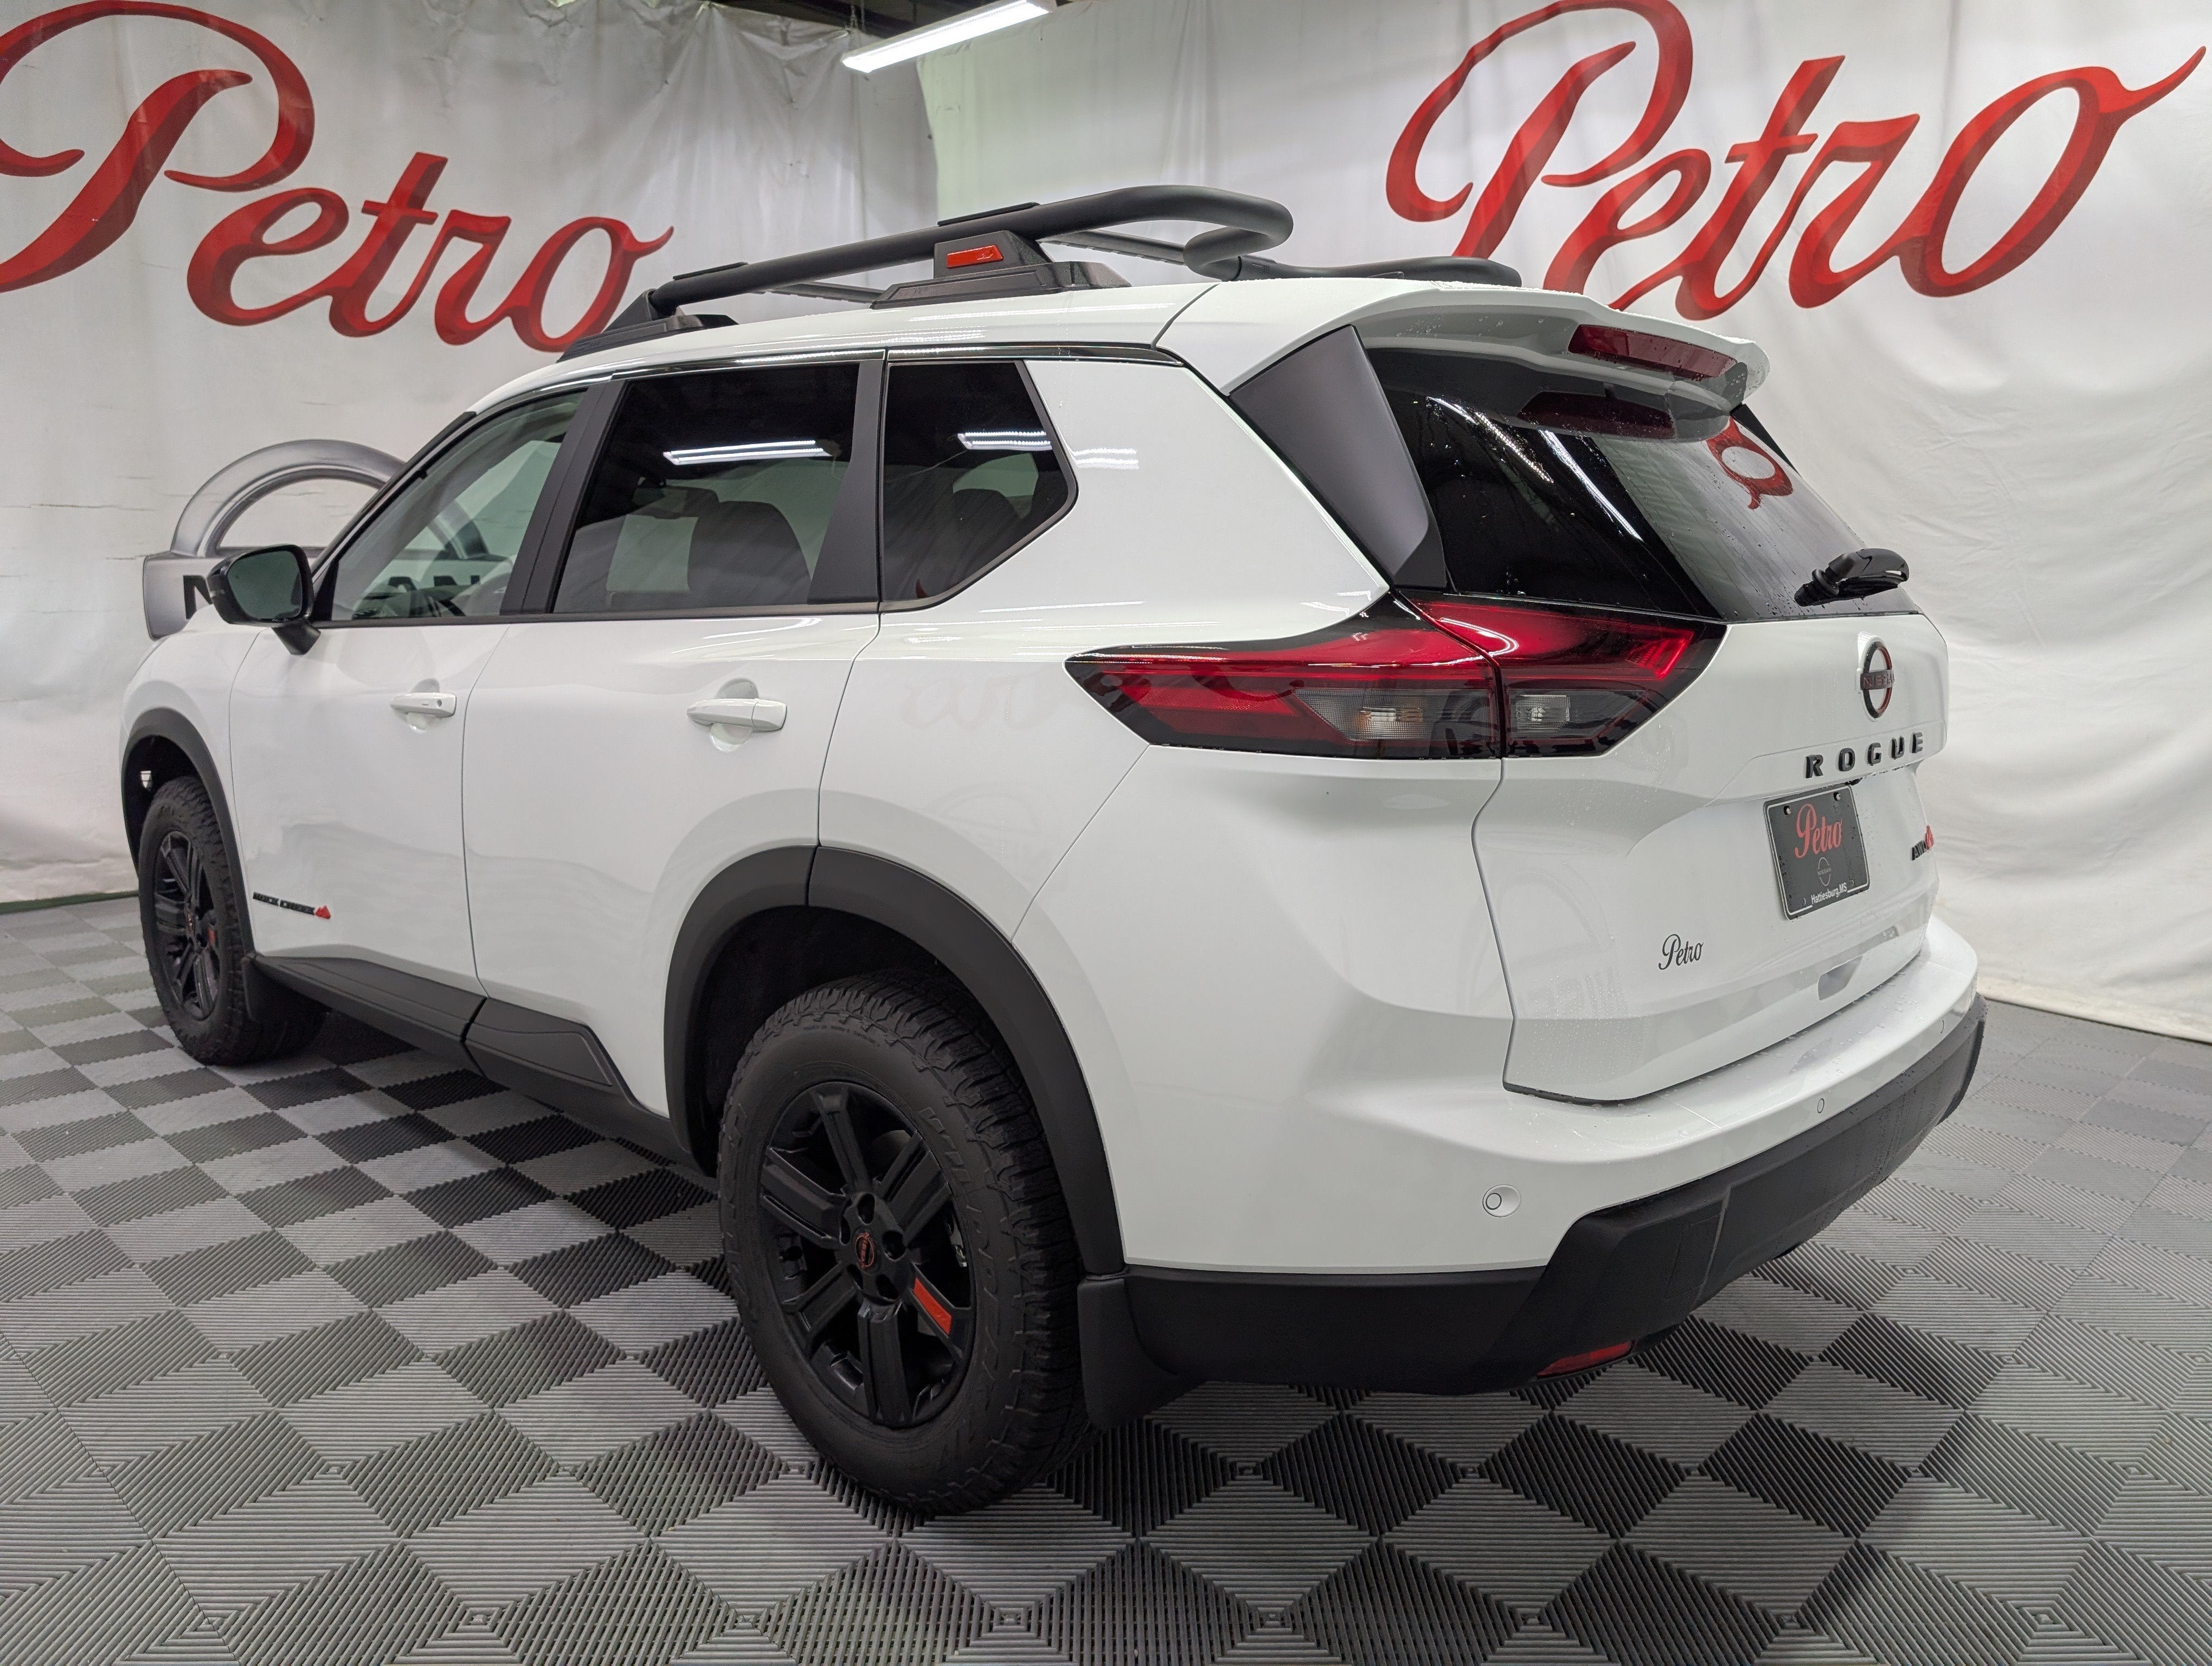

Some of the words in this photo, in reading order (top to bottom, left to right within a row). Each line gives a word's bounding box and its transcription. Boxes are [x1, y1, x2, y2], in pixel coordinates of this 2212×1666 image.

[0, 0, 674, 352] Petro
[1386, 0, 2207, 321] Petro
[1805, 732, 1924, 779] ROGUE
[1794, 803, 1843, 858] Petro
[1658, 933, 1704, 970] Petro
